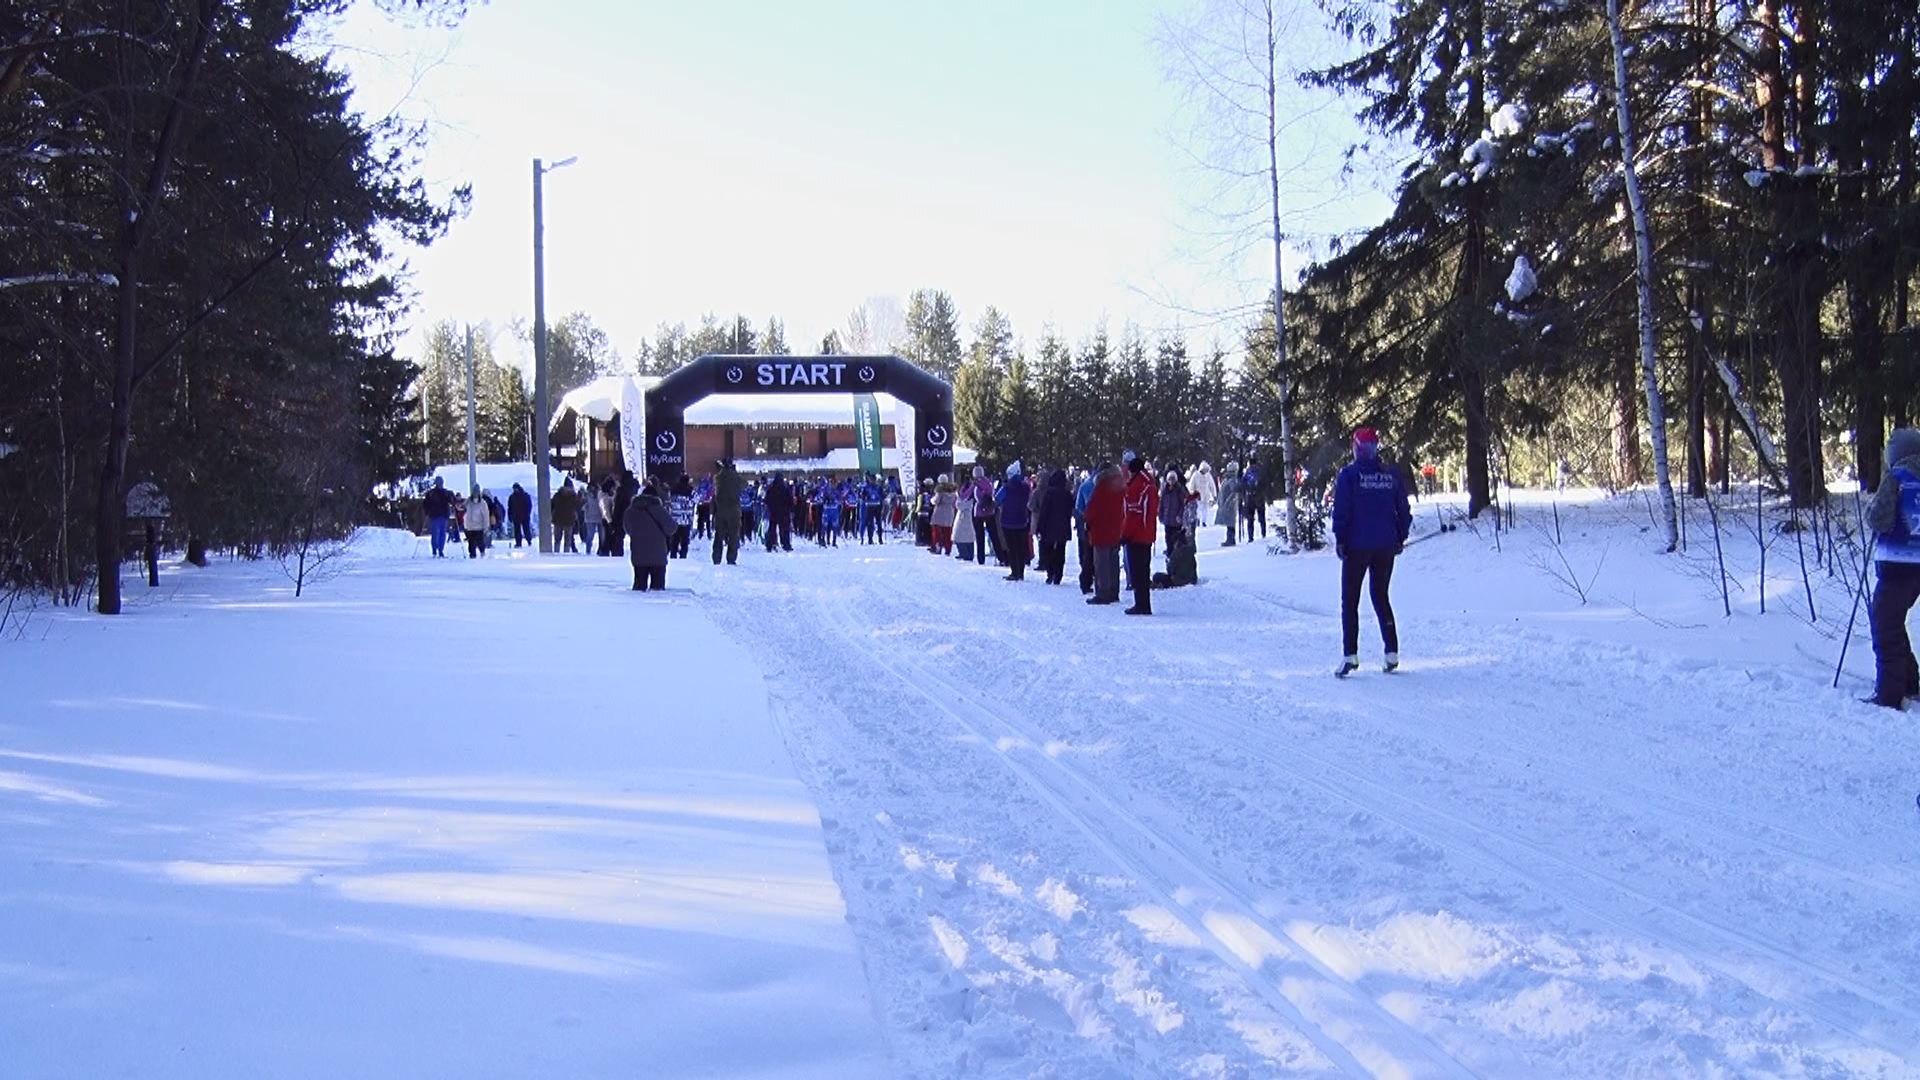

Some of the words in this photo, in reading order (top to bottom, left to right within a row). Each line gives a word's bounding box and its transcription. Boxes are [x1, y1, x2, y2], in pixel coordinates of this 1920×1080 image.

[757, 363, 847, 386] START
[649, 453, 682, 465] MyRace
[921, 448, 952, 459] MyRace
